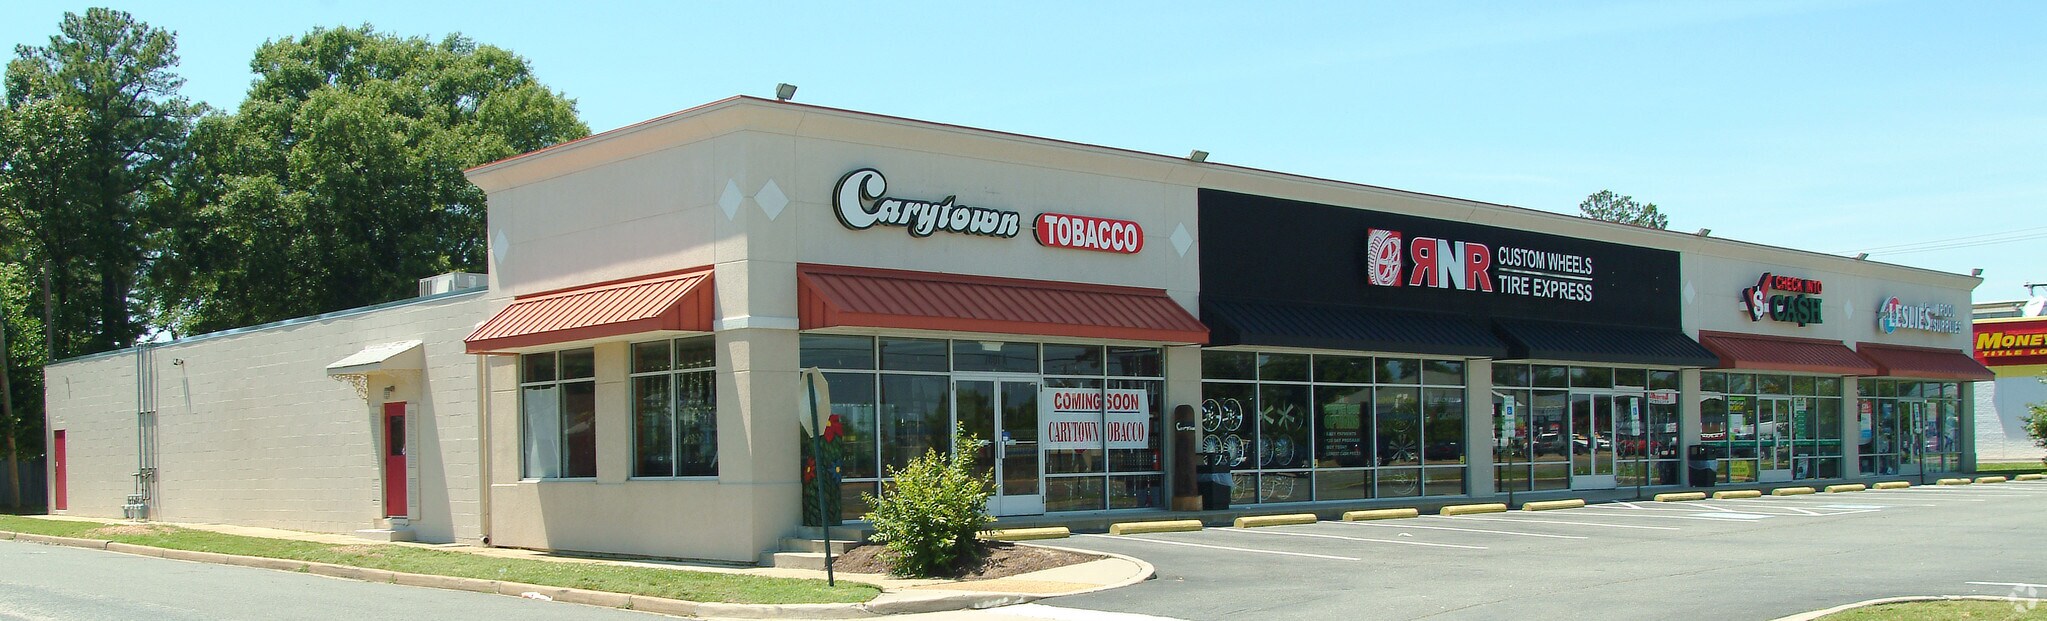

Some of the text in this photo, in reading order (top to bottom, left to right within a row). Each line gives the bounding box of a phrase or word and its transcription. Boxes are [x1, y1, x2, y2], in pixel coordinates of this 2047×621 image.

[832, 168, 1019, 238] Carytown
[1044, 215, 1138, 253] TOBACCO
[1498, 246, 1592, 275] CUSTOM WHEELS
[1498, 274, 1592, 302] TIRE EXPRESS
[1773, 275, 1822, 294] CHECK INTO
[1889, 303, 1931, 330] LESLIE'S
[1932, 319, 1961, 334] SUPPLIES
[1054, 392, 1139, 410] COMING SOON
[1048, 421, 1145, 442] CARYTOWN OBACCO
